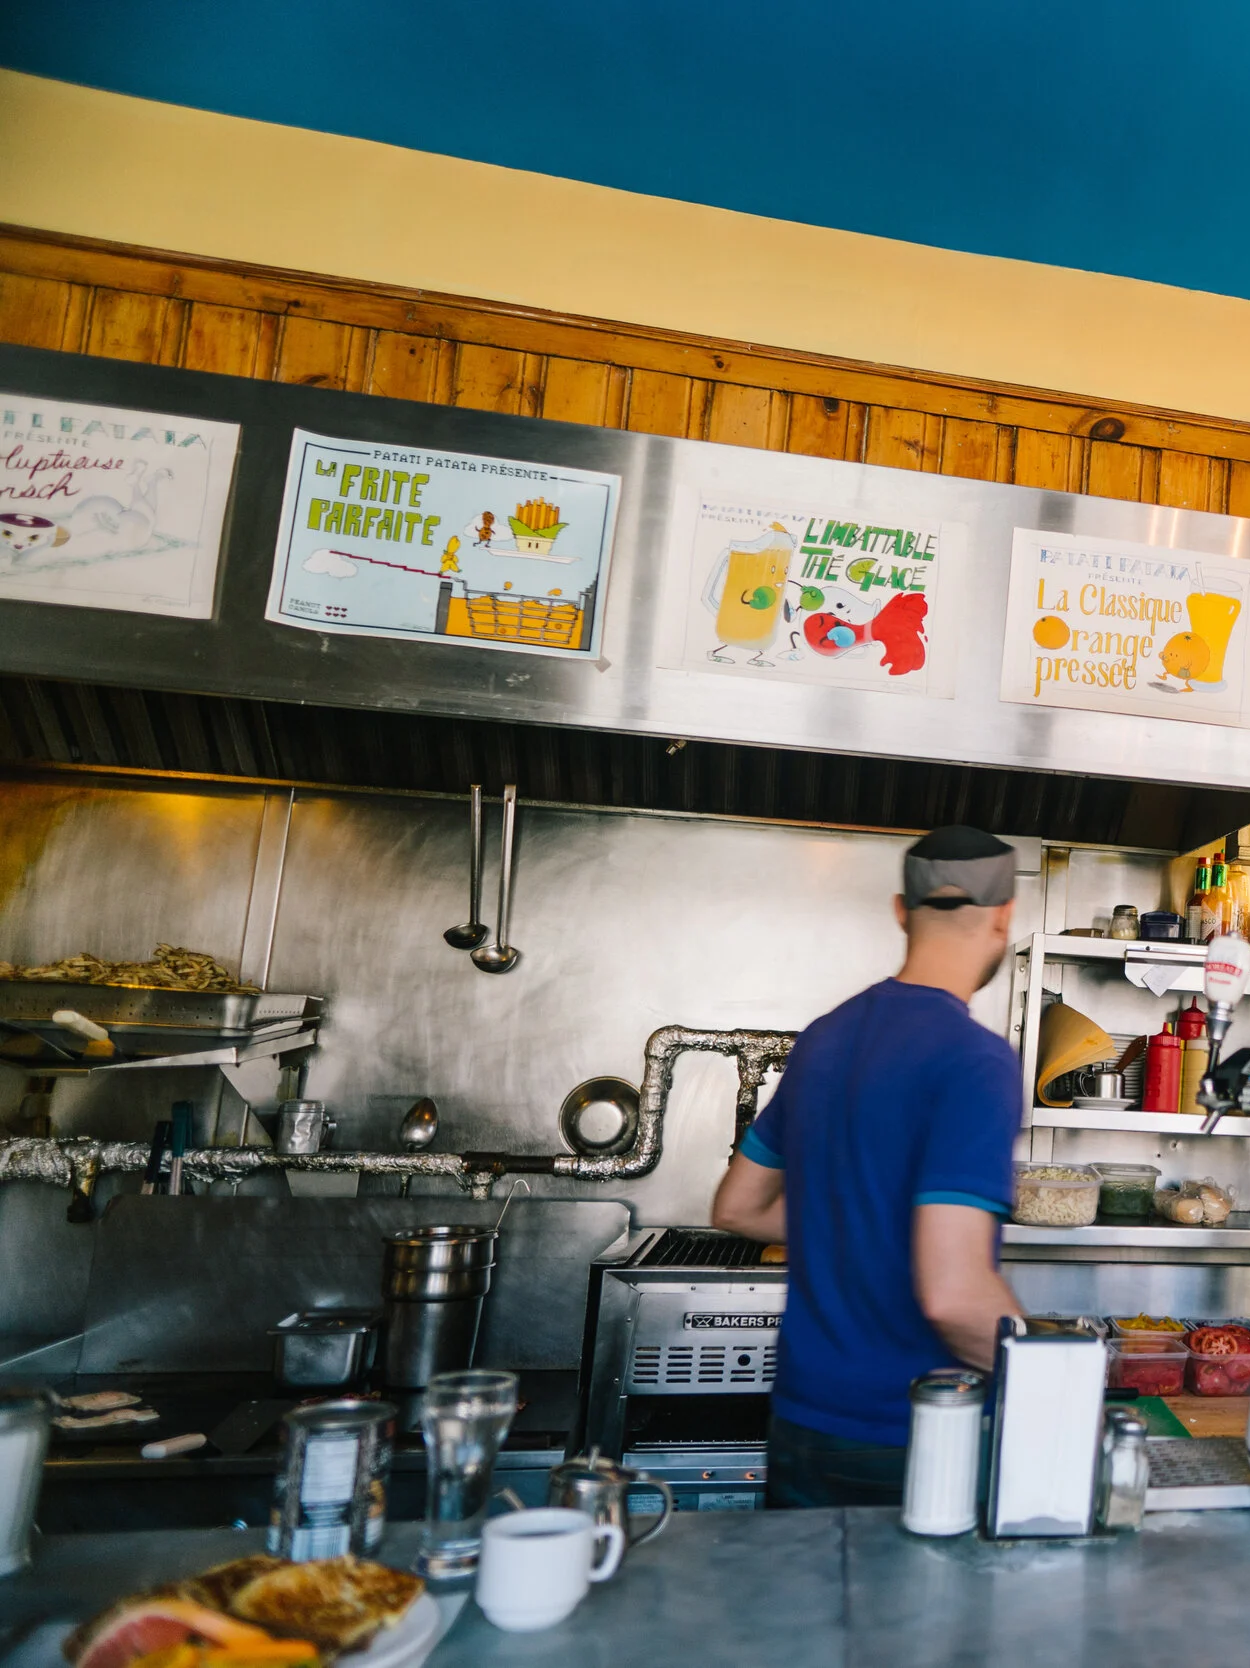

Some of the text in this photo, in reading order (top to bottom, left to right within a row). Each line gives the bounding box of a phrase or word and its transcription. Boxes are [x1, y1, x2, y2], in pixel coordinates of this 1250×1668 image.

[1, 444, 124, 480] luptueuse
[315, 459, 430, 507] LA FRITE
[373, 450, 548, 481] PATATI PATATA PRÉSENTE
[307, 497, 441, 546] PARFAITE
[803, 517, 938, 561] L'IMBATTABLE
[799, 546, 927, 592] THÉ GLACÉ
[1037, 578, 1182, 636] La Classique
[1033, 656, 1137, 698] pressée
[714, 1316, 764, 1327] BAKERS
